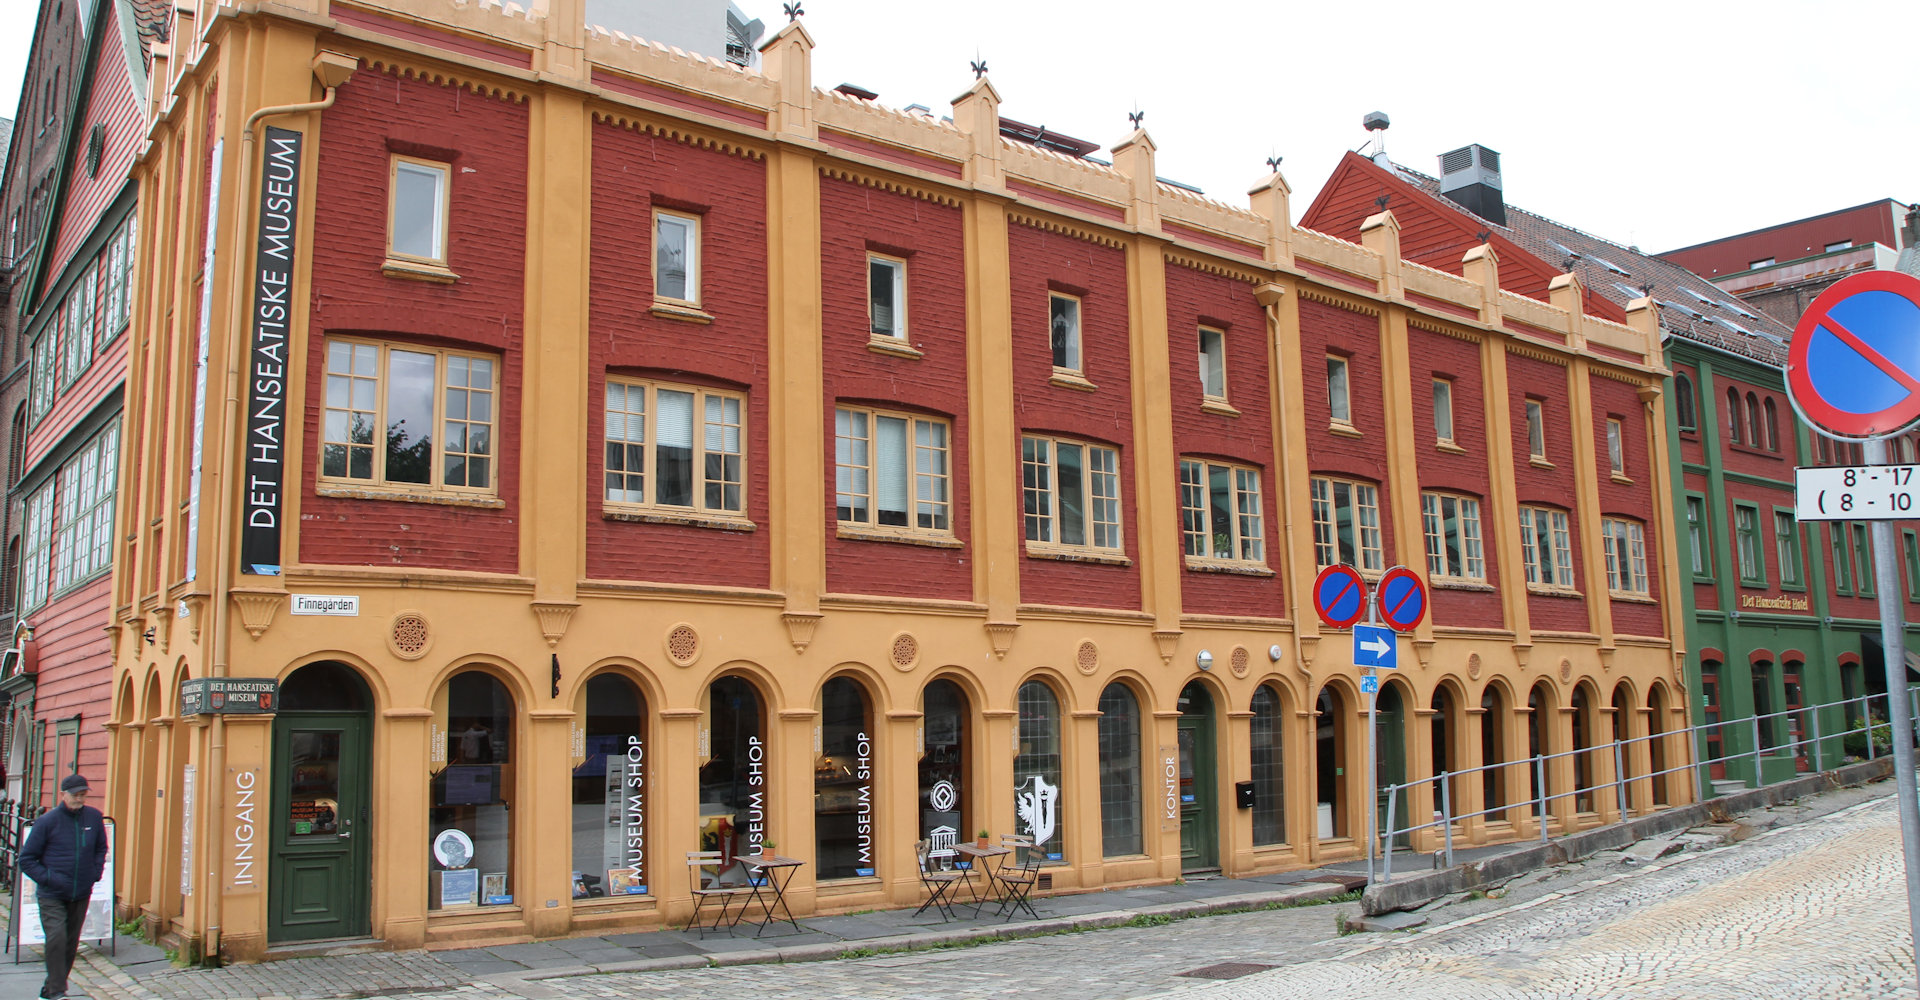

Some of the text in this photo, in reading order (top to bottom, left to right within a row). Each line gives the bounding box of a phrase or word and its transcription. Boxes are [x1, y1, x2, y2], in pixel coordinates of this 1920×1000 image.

[249, 138, 296, 528] DET HANSEATISKE MUSEUM
[1843, 469, 1856, 487] 8
[1892, 467, 1913, 486] 17
[1840, 493, 1853, 512] 8
[1889, 492, 1912, 511] 10
[298, 597, 353, 613] Finnegården
[1742, 594, 1808, 610] Det Hanseatiske Hotel
[210, 682, 274, 692] DET HANSEATISKE
[228, 693, 257, 702] MUSEUM
[628, 735, 643, 788] SHOP
[749, 735, 763, 786] SHOP
[857, 732, 870, 780] SHOP
[1165, 756, 1176, 819] KONTOR
[233, 771, 255, 885] INNGANG
[628, 794, 643, 880] MUSEUM
[858, 785, 871, 863] MUSEUM
